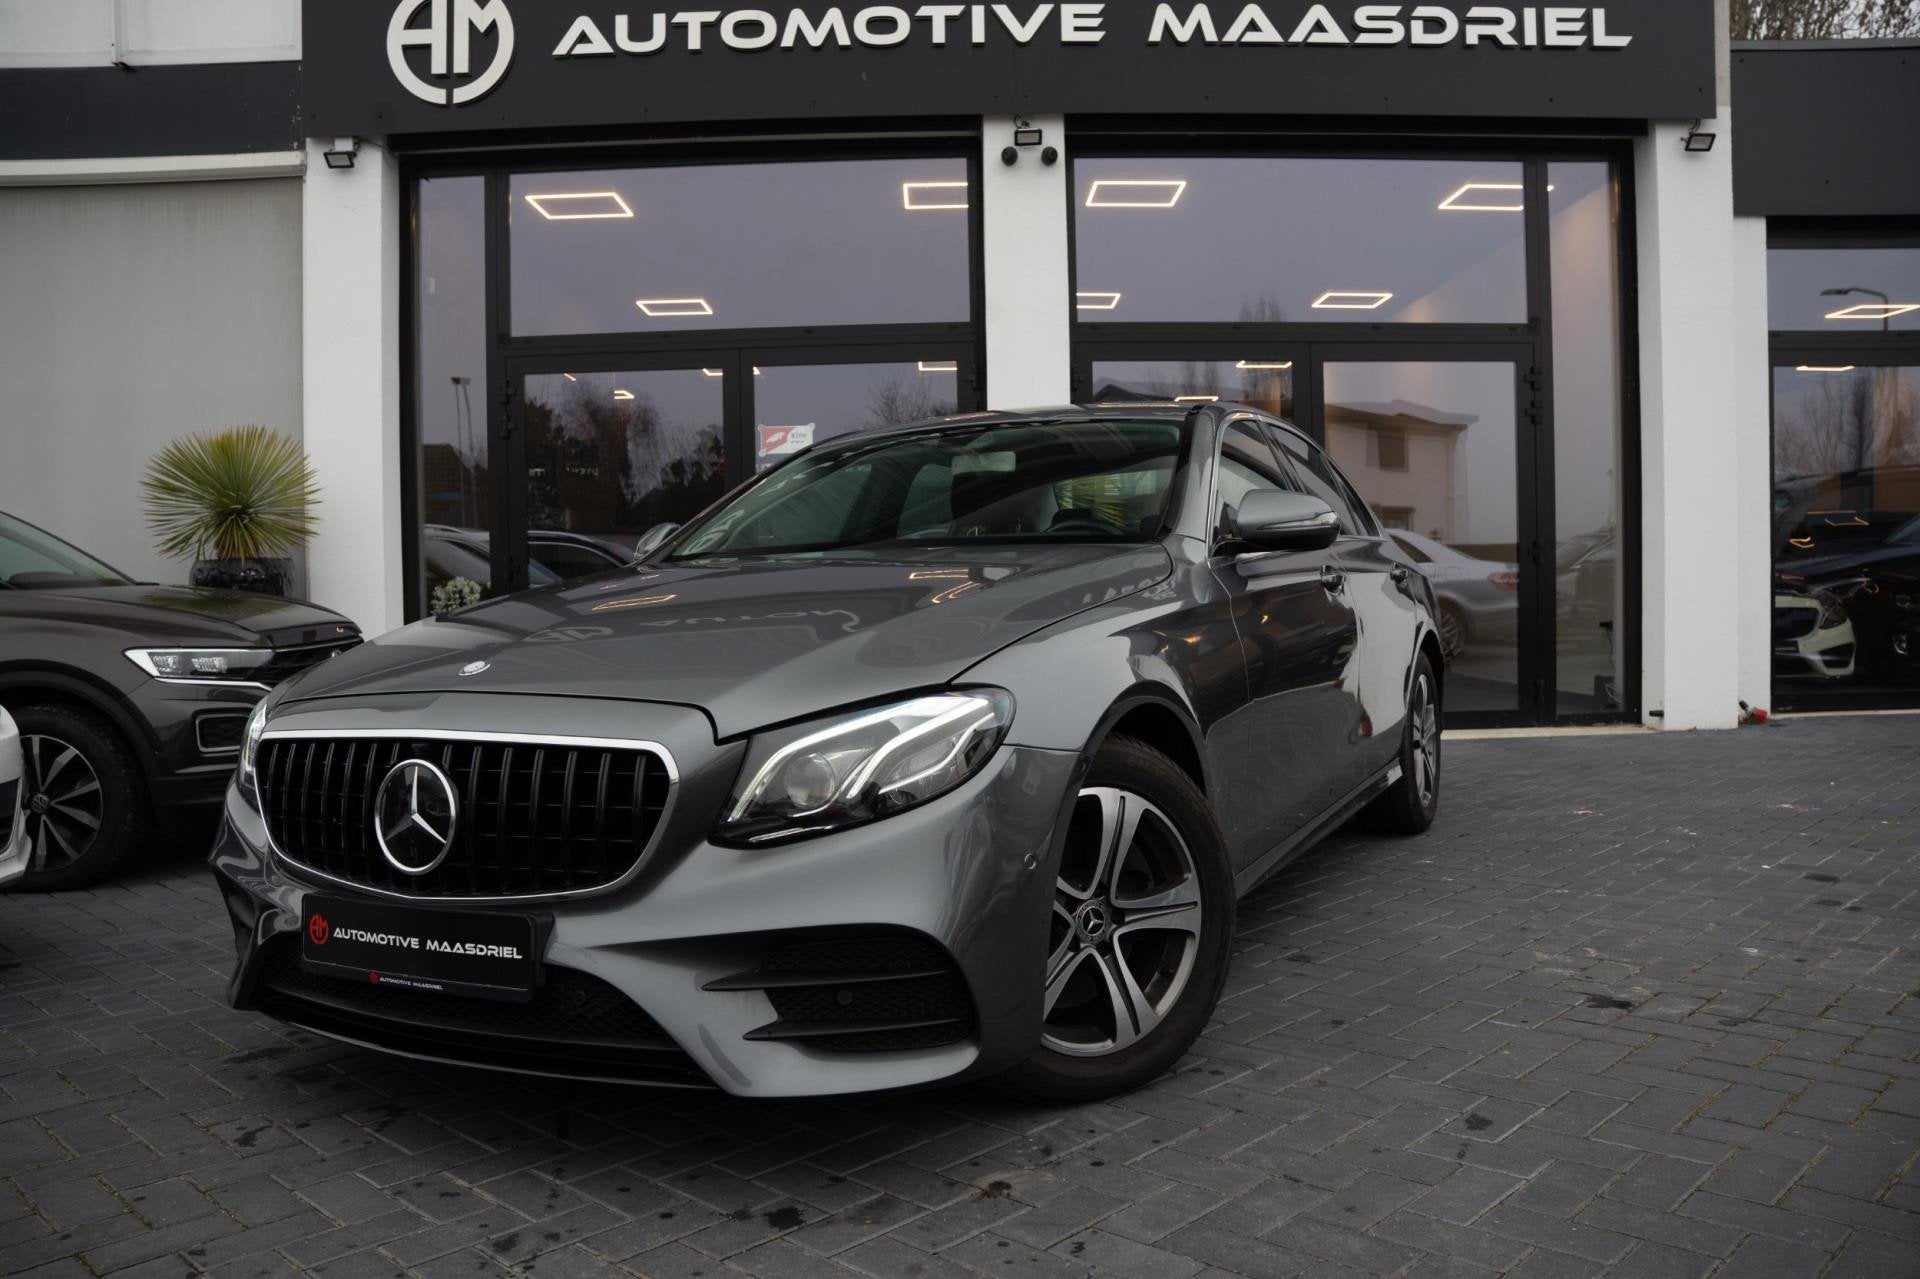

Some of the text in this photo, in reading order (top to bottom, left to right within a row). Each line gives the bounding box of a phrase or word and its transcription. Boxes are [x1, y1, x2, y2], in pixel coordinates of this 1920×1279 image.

[552, 4, 1106, 56] AUTOMOTIVE
[1147, 3, 1633, 47] MAASDRIEL
[333, 928, 420, 949] AUTOMOTIVE
[426, 939, 523, 960] MAASDRIEL
